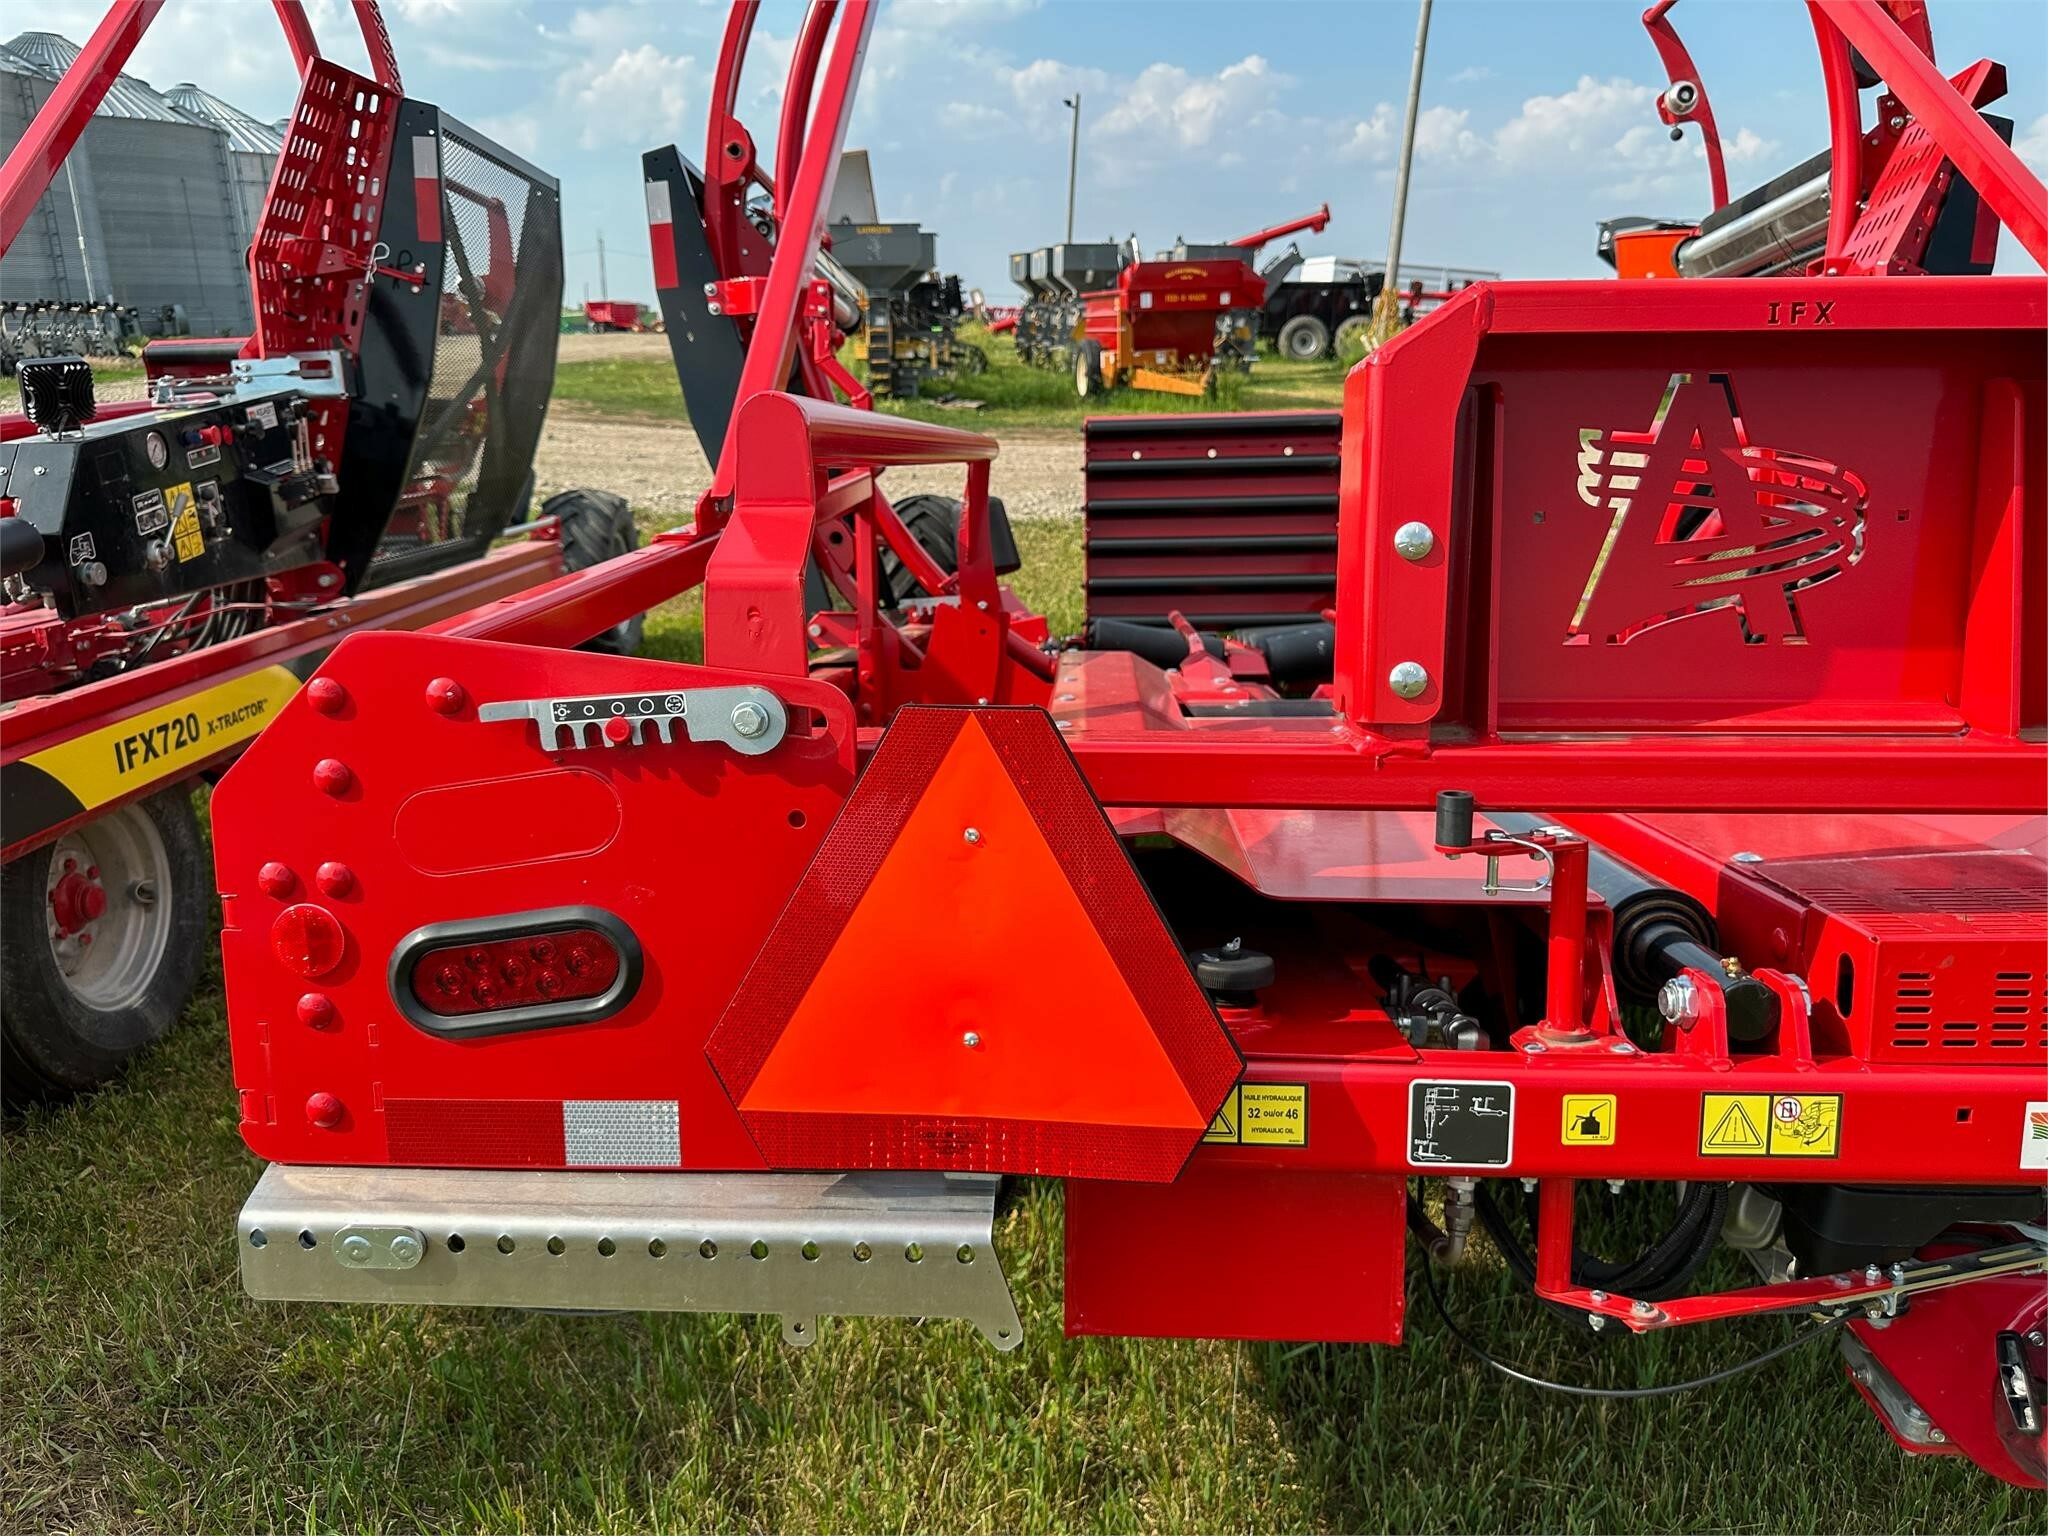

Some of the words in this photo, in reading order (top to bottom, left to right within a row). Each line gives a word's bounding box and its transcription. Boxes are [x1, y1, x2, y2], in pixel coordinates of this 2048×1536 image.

[1768, 301, 1835, 325] IFX
[114, 712, 200, 774] IFX720
[1261, 1094, 1302, 1102] HYDRAULIQUE
[1247, 1107, 1260, 1119] 32
[1263, 1109, 1283, 1117] ou/or
[1285, 1108, 1299, 1120] 46
[1285, 1127, 1295, 1135] OIL
